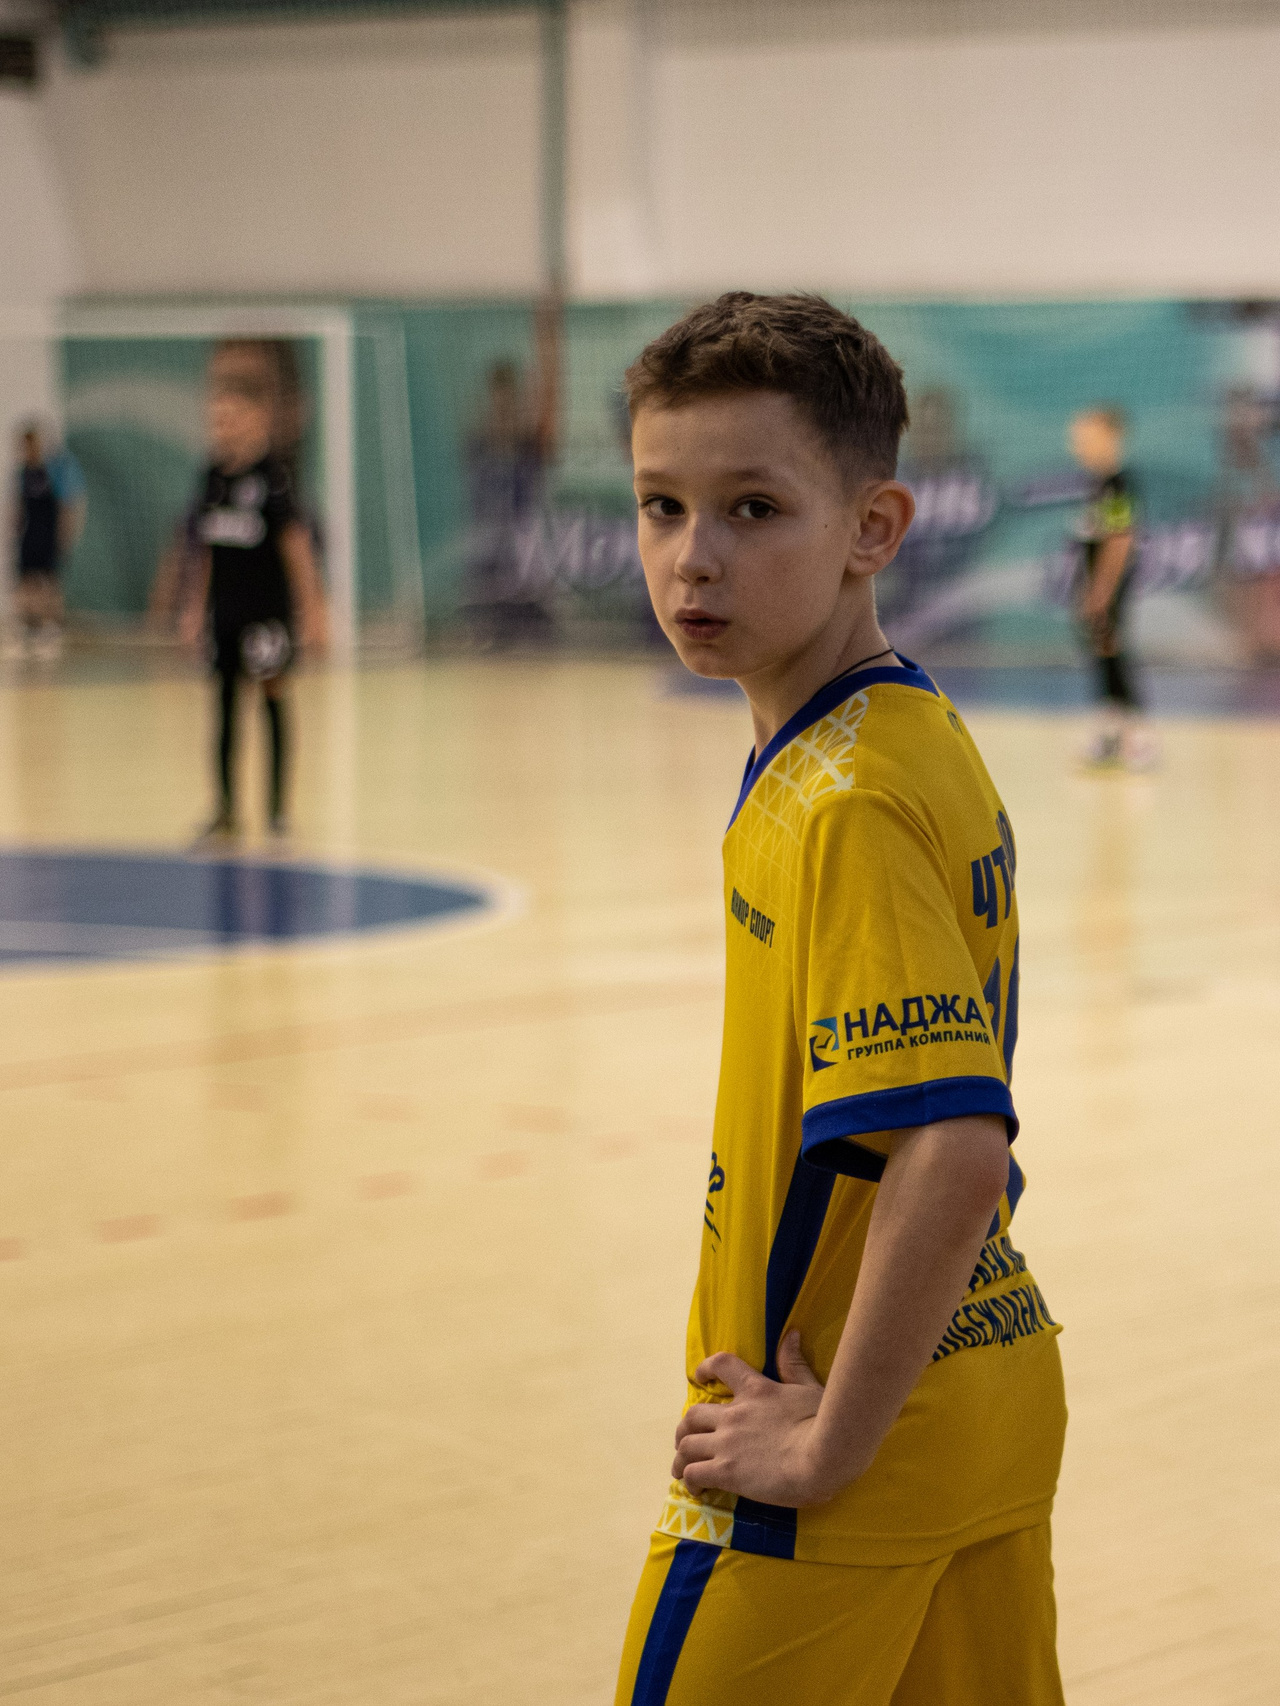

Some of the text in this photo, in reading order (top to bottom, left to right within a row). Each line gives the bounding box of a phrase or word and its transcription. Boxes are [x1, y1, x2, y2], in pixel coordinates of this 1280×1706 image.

[750, 907, 775, 949] СПОРТ
[844, 994, 987, 1042] НАДЖА
[847, 1030, 991, 1060] ГРУППА КОМПАНИЙ
